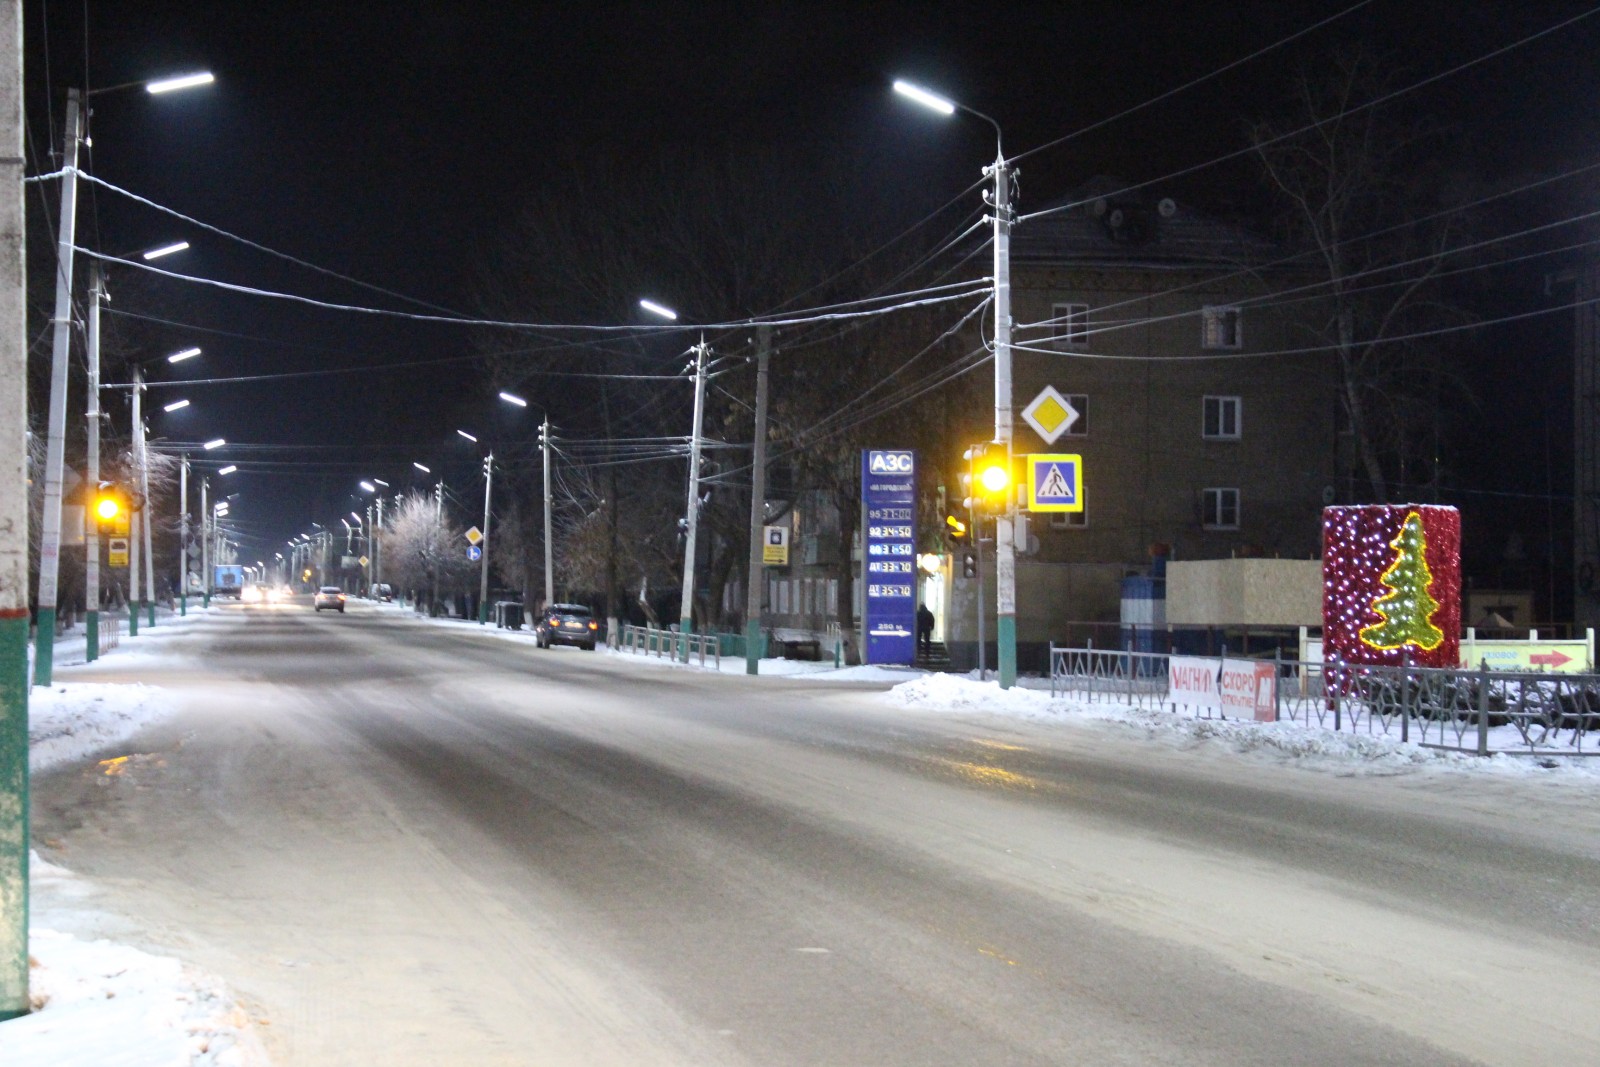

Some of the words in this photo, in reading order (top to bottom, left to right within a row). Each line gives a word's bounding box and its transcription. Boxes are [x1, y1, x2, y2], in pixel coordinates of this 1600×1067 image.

[872, 454, 911, 471] АЗС
[869, 510, 881, 519] 95
[869, 527, 881, 537] 92
[1222, 671, 1254, 692] СКОРО
